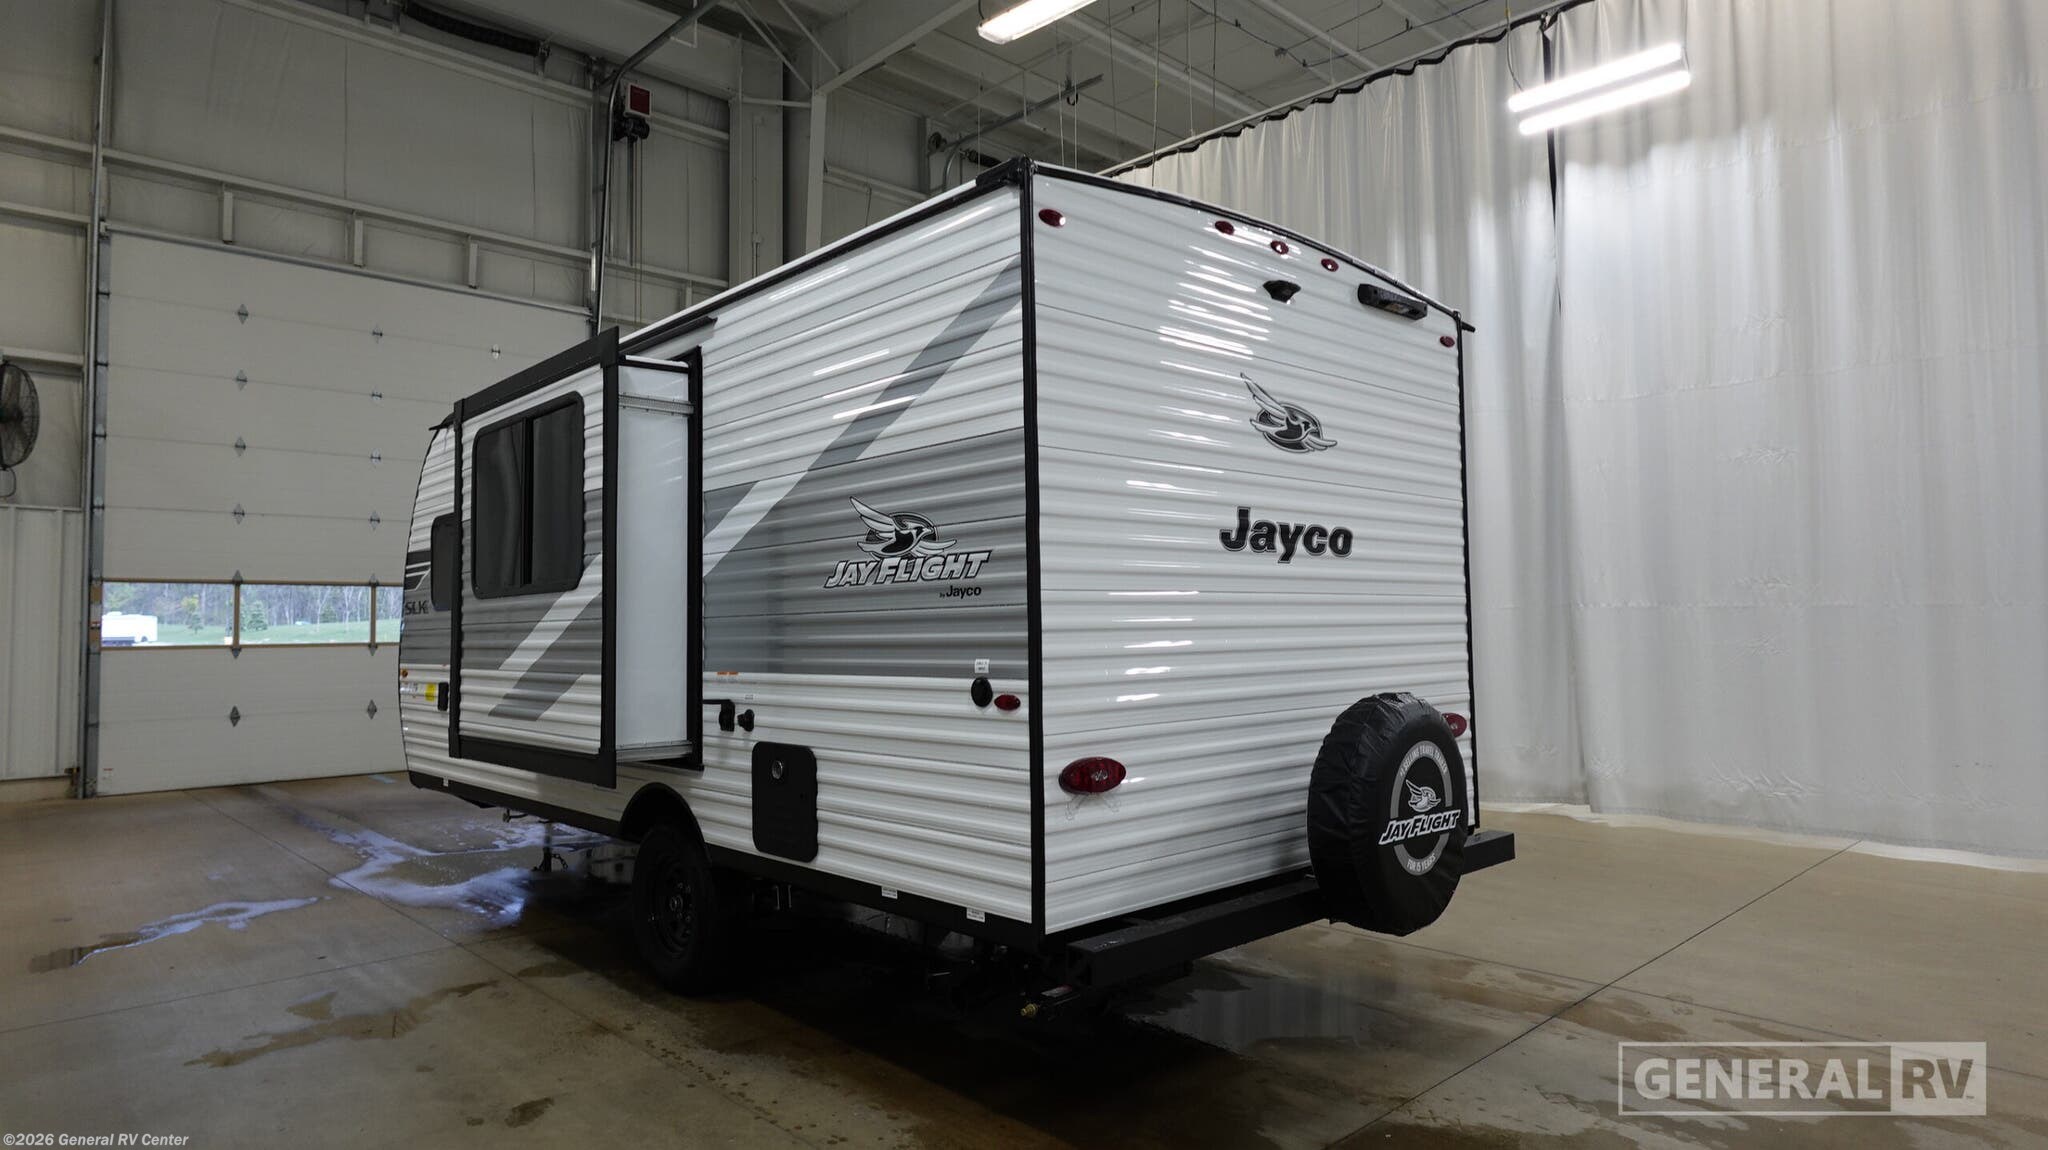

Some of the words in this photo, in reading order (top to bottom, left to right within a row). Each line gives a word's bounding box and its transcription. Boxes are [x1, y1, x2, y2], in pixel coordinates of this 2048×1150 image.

[1219, 506, 1353, 564] Jayco
[824, 561, 879, 588] JAY
[874, 550, 992, 585] FLIGHT
[404, 600, 429, 615] SLK
[946, 585, 982, 599] Jayco
[1379, 819, 1412, 845] JAY
[1407, 809, 1461, 839] FLIGHT
